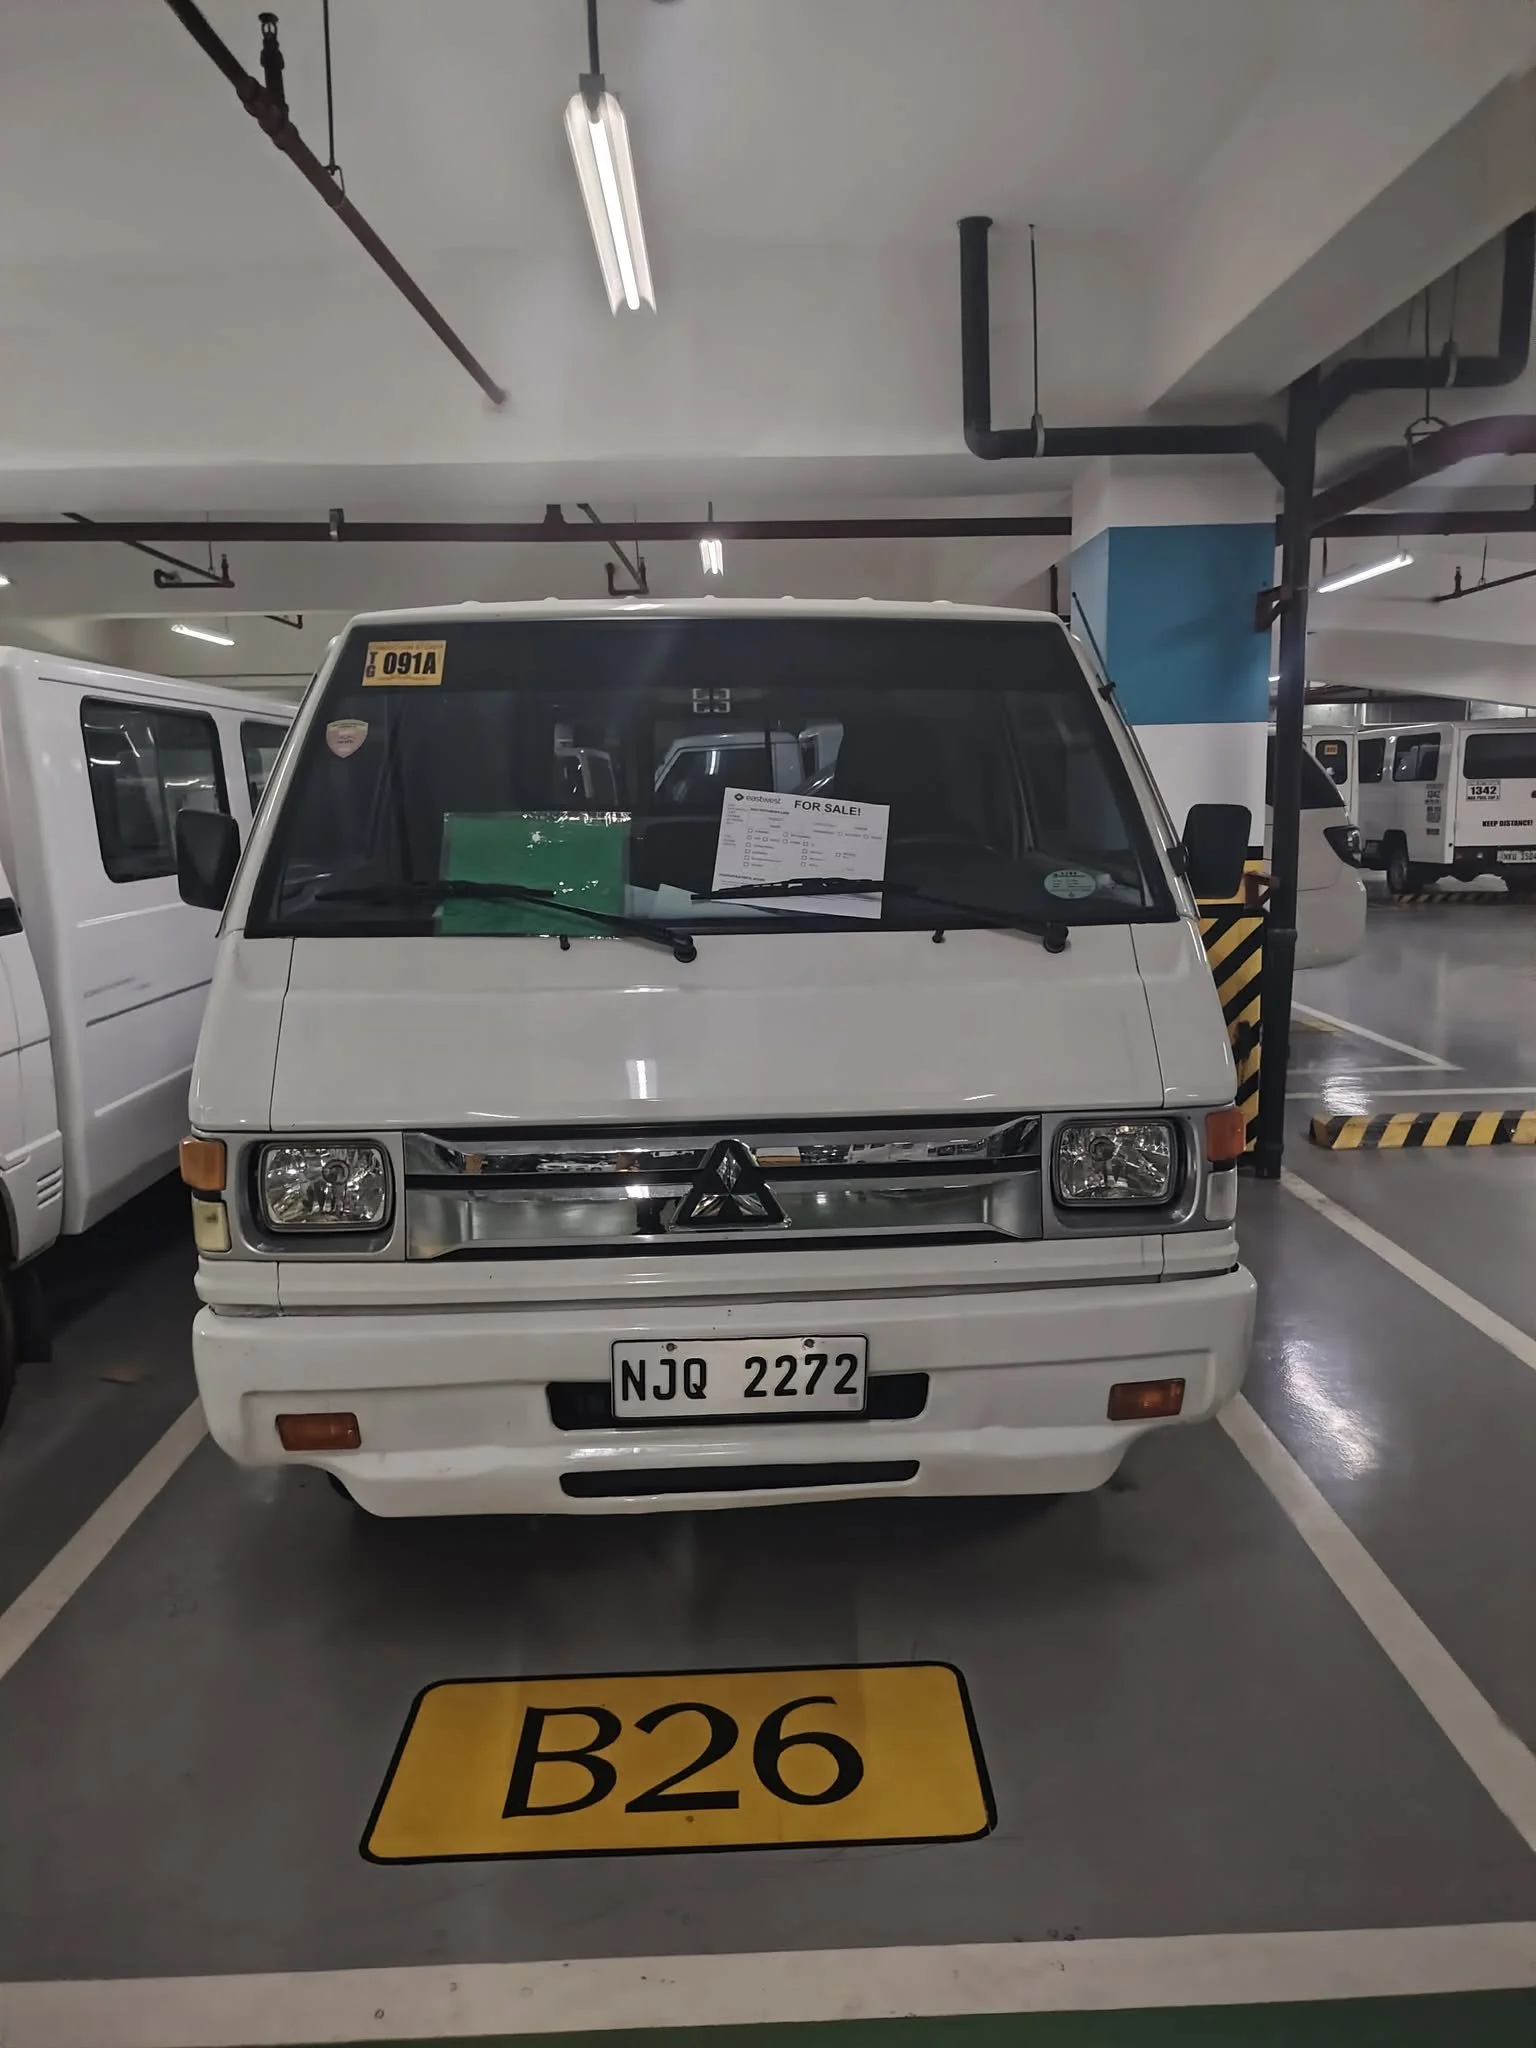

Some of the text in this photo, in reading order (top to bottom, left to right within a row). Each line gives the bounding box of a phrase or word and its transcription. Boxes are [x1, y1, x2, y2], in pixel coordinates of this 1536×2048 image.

[383, 651, 436, 675] 091A
[1470, 786, 1497, 795] 1342
[794, 800, 821, 812] FOR
[824, 803, 861, 816] SALE!
[1499, 819, 1533, 827] DISTANCE!
[621, 1353, 858, 1402] NJQ 2272
[502, 1696, 864, 1819] B26
